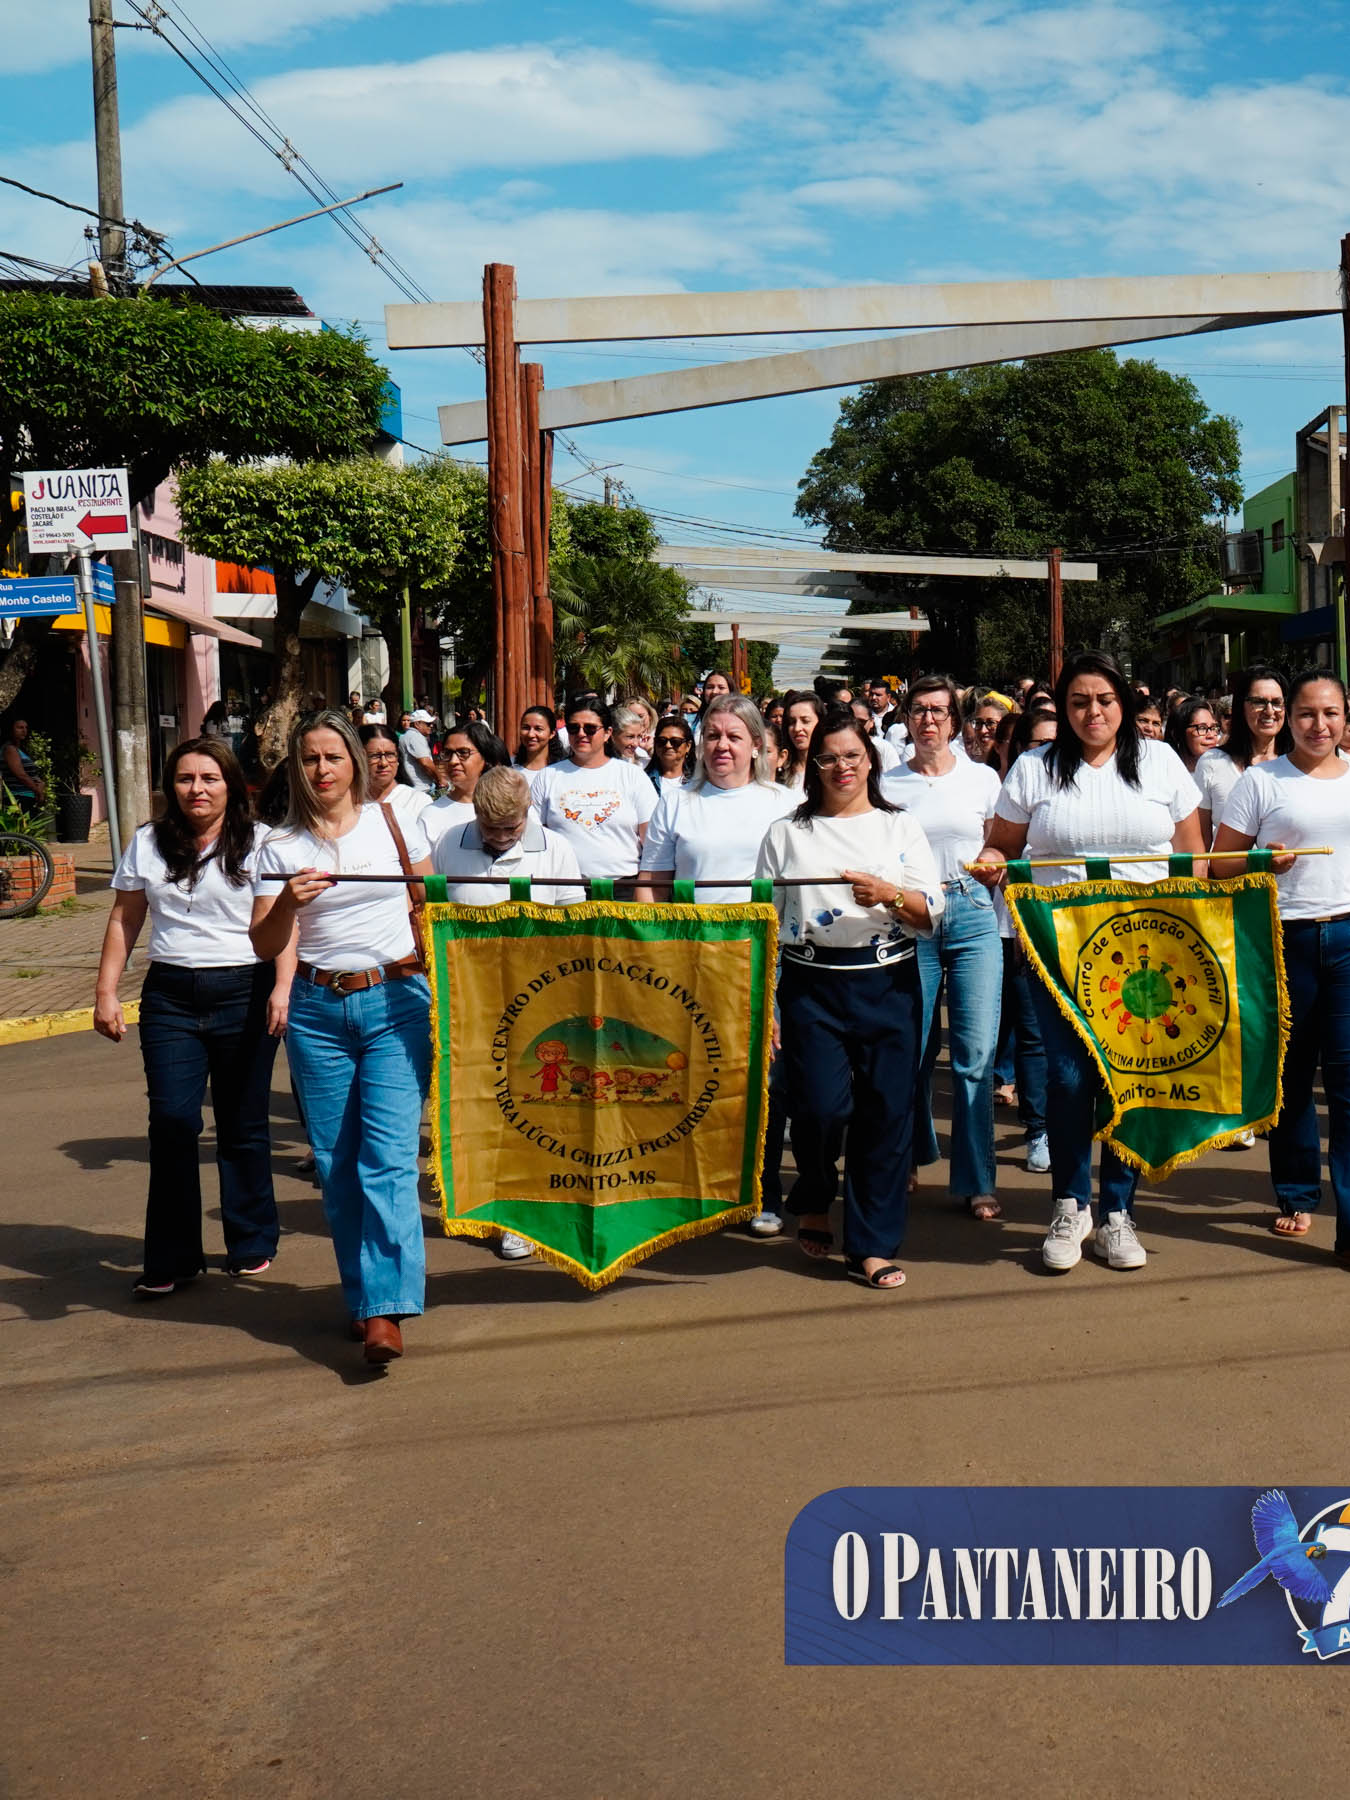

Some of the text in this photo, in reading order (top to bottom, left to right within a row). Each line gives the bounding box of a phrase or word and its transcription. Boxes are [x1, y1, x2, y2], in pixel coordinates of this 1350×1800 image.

[31, 474, 122, 500] JUANITA
[77, 498, 123, 507] RESTAURANTE
[32, 594, 72, 604] Castelo
[1083, 918, 1223, 1018] Centro de Educação Infantil
[492, 957, 722, 1064] CENTRO DE EDUCAÇÃO INFANTIL
[1177, 1024, 1217, 1062] COELHO
[1117, 1083, 1201, 1105] onito-MS
[494, 1076, 720, 1168] VERA LÚCIA GHIZZI FIGUEIREDO
[550, 1170, 656, 1191] BONITO-MS
